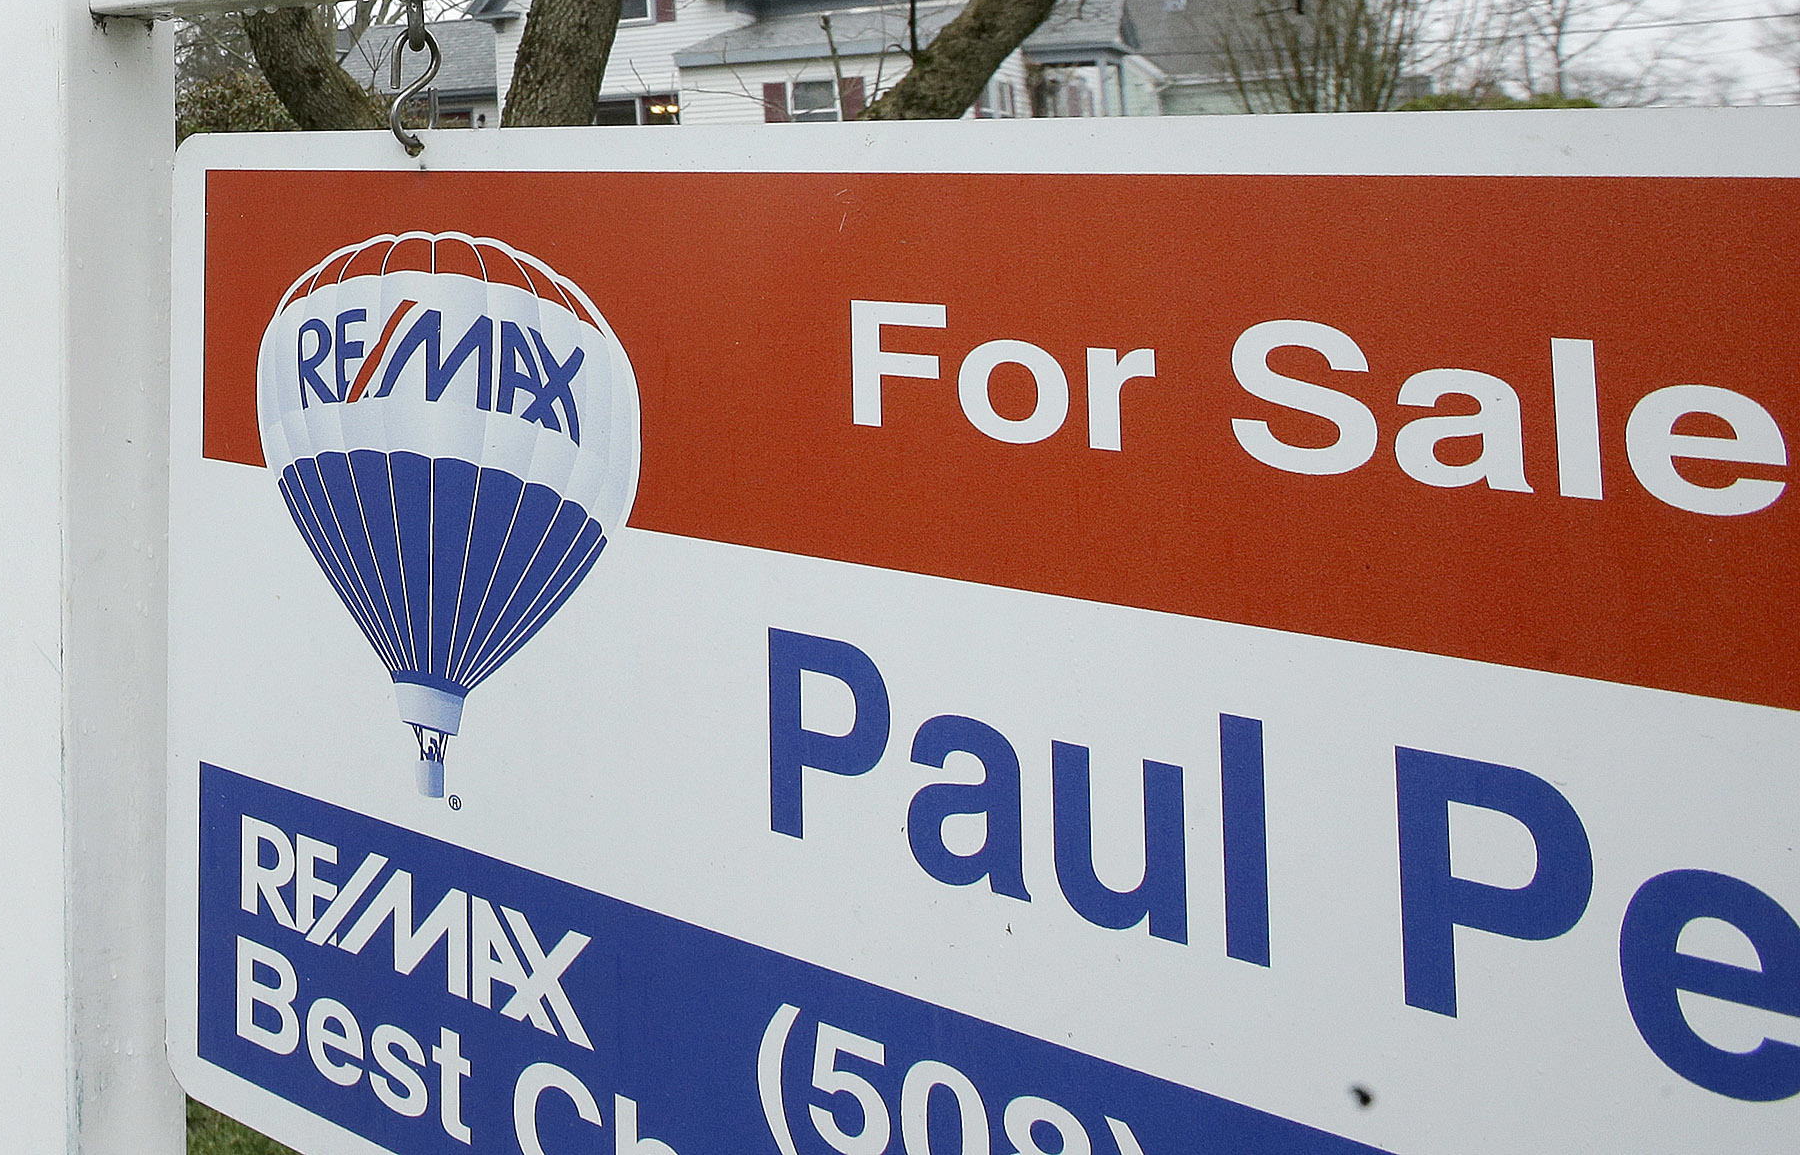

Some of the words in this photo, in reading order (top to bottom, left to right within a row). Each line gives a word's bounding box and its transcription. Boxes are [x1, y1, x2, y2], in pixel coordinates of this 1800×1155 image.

[298, 299, 585, 448] RE/MAX
[850, 299, 1155, 451] For
[1230, 319, 1789, 517] Sale
[241, 814, 595, 1052] RE/MAX
[768, 626, 1271, 969] Paul
[1394, 745, 1800, 1103] Pe
[236, 935, 472, 1146] Best
[757, 1003, 1145, 1155] (50
